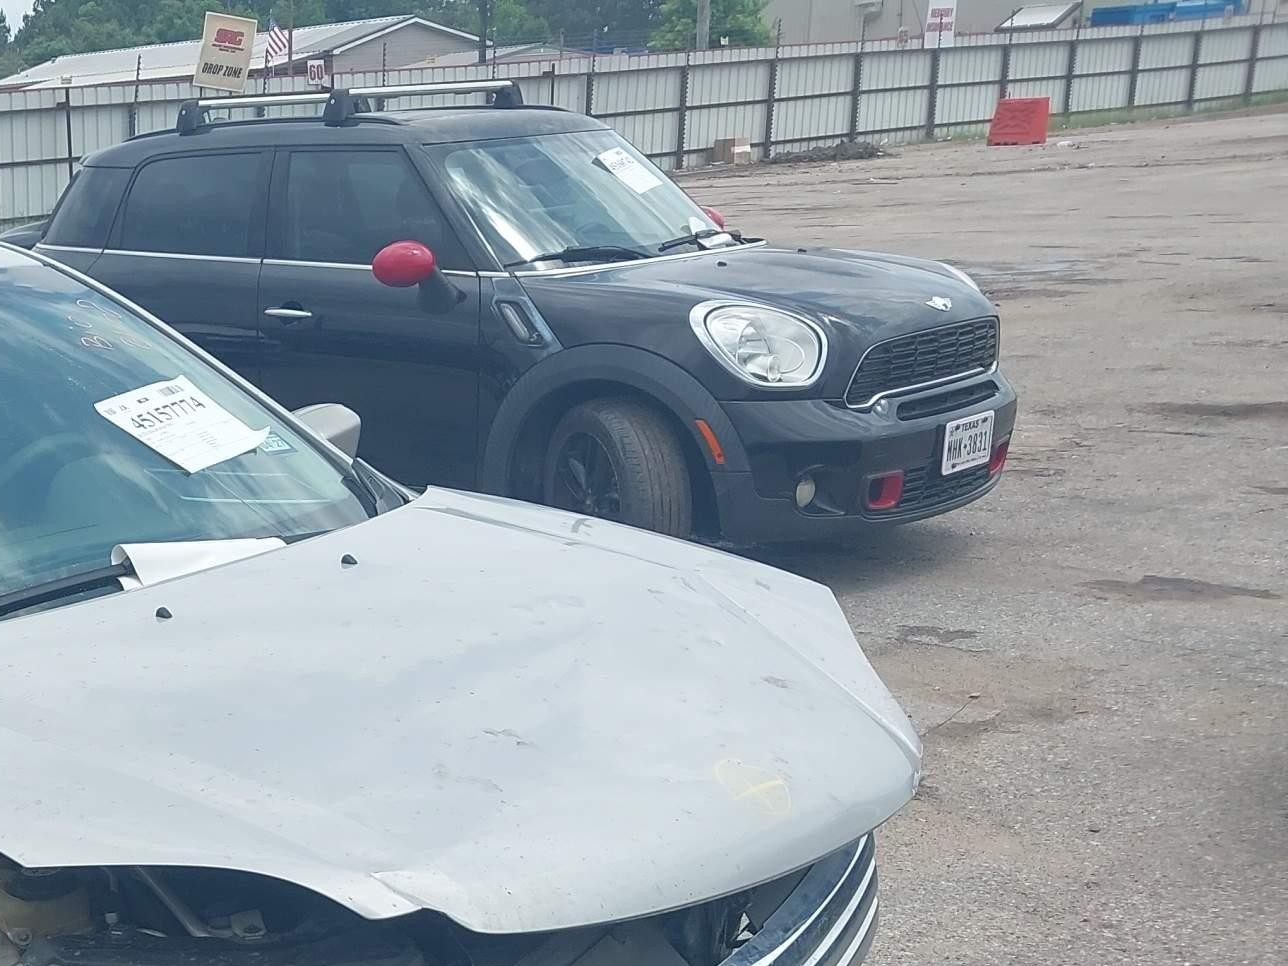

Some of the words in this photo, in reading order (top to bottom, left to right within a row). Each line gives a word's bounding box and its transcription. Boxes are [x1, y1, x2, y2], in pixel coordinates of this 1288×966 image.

[202, 62, 223, 75] DROP
[223, 65, 244, 79] ZONE
[309, 64, 324, 81] 60
[130, 396, 206, 429] 45157774
[962, 419, 980, 432] TEXAS
